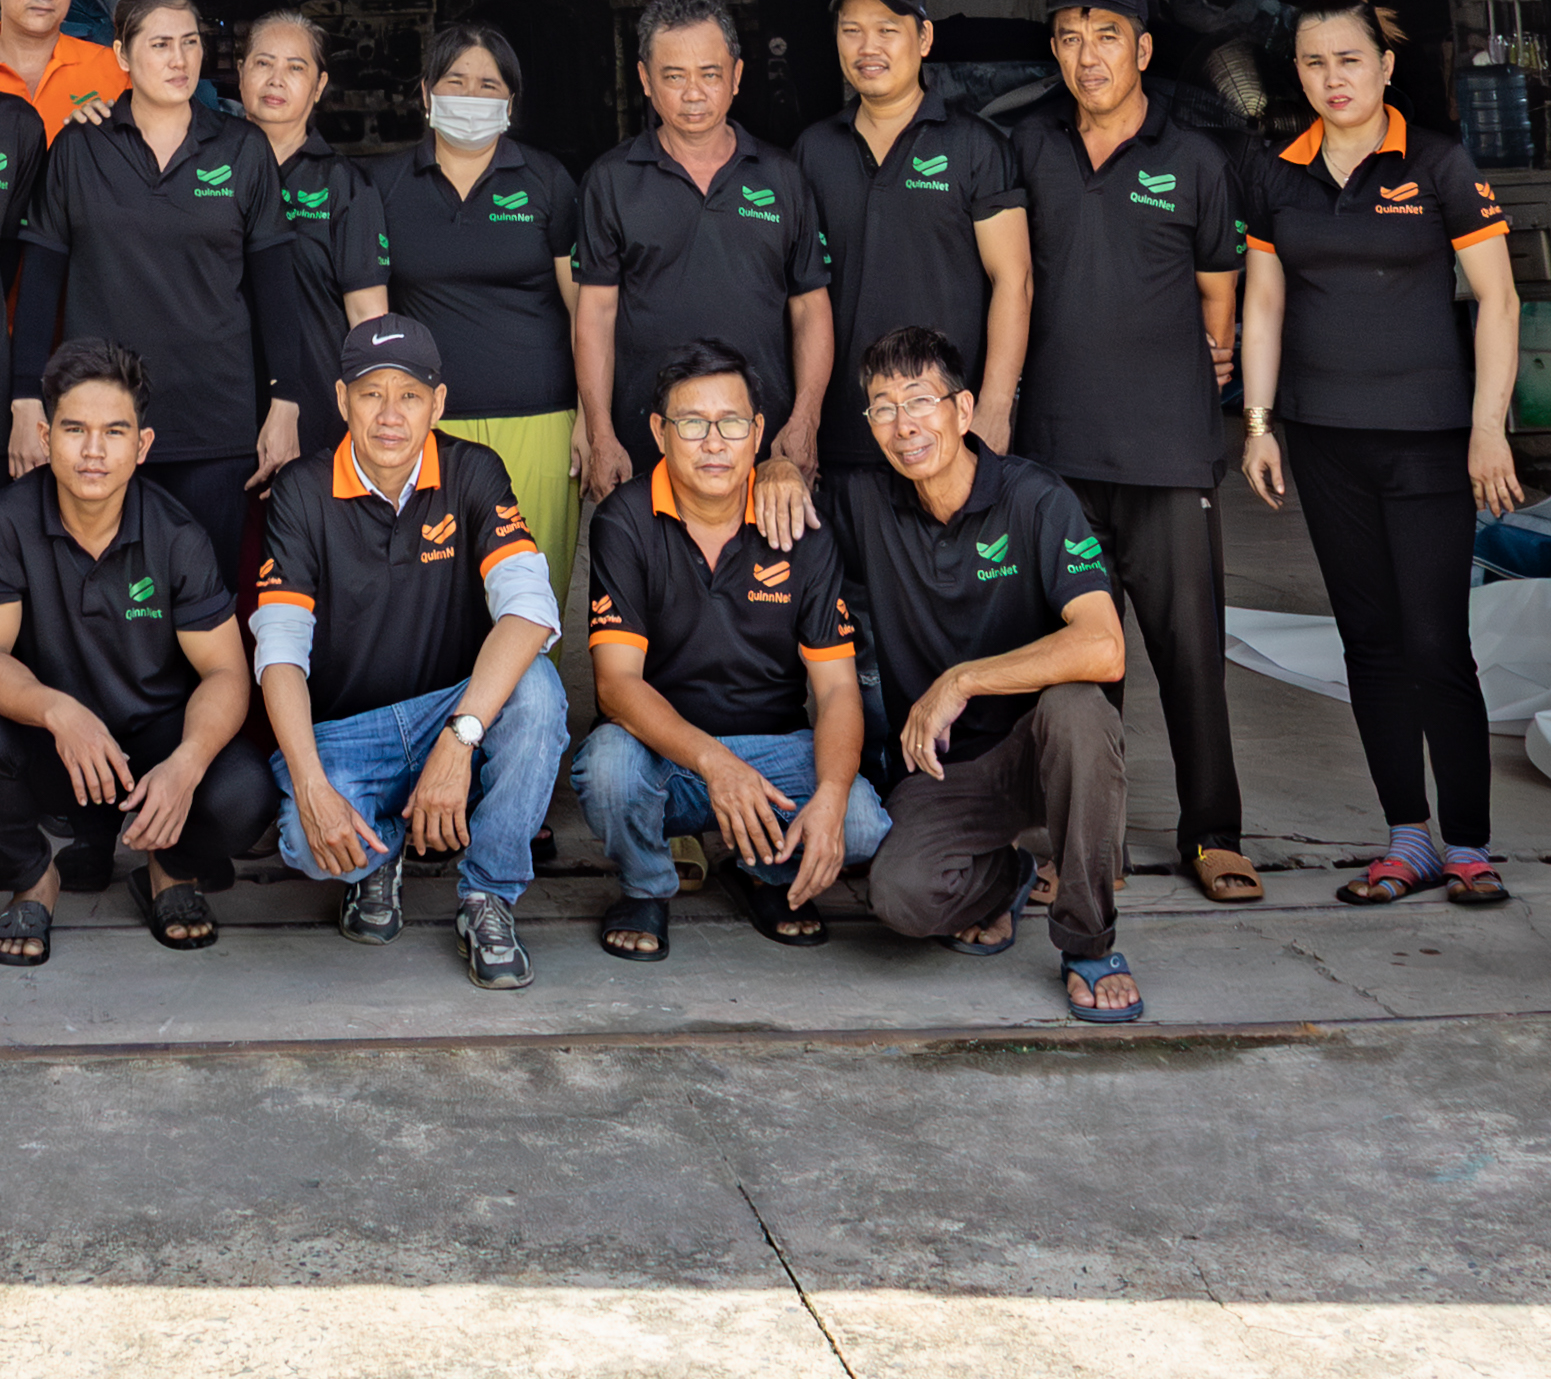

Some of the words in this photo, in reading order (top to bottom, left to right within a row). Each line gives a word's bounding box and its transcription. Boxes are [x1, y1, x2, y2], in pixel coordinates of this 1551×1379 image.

[905, 179, 949, 191] QuinnNet
[1130, 191, 1175, 212] QuinnNet
[738, 207, 780, 223] QuinnNet
[1375, 204, 1424, 215] QuinnNet
[489, 212, 534, 222] QuinnNet
